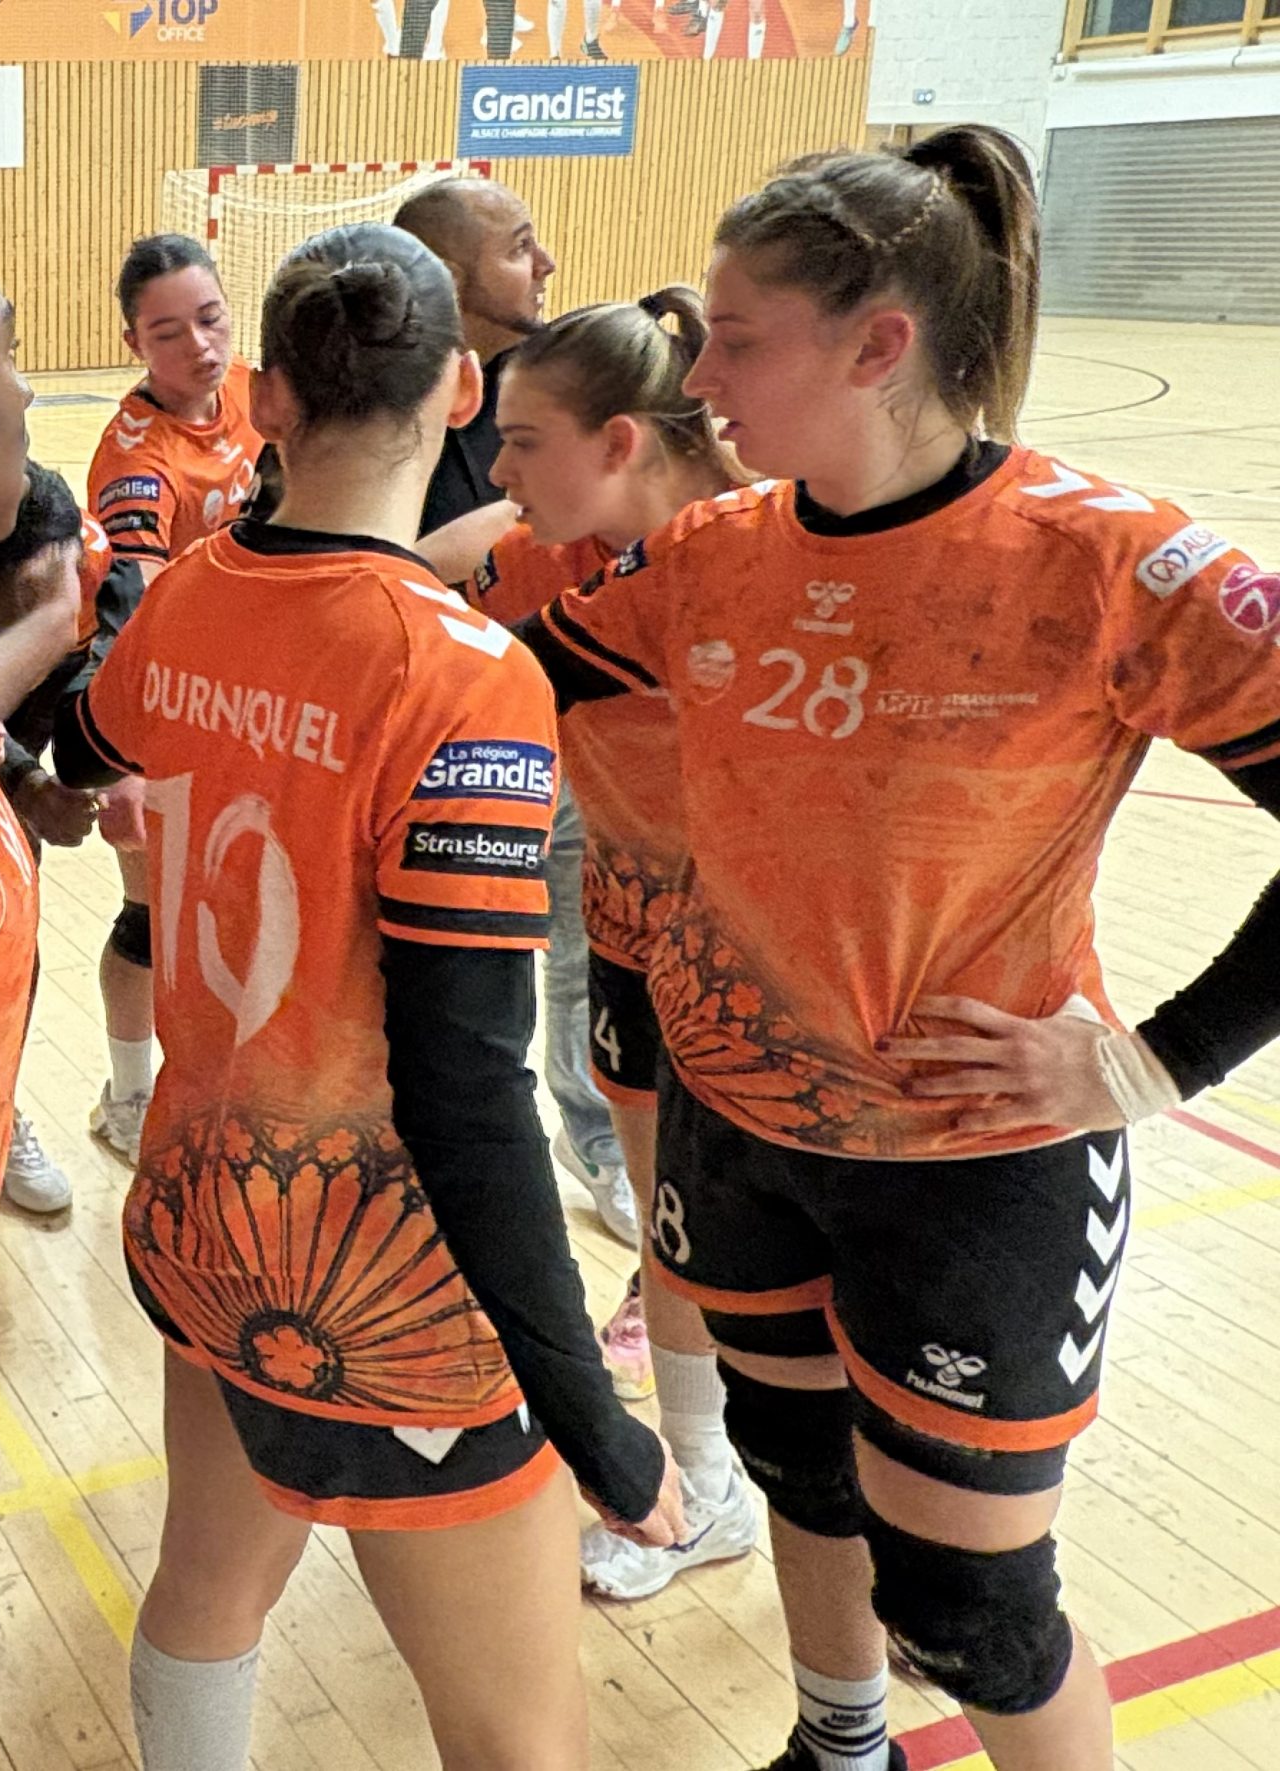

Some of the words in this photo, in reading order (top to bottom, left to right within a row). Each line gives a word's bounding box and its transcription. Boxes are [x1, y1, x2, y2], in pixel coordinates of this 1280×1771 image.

[157, 27, 206, 42] OFFICE
[742, 648, 869, 740] 28
[448, 748, 468, 761] La
[471, 746, 519, 762] Région
[655, 1181, 692, 1265] 8
